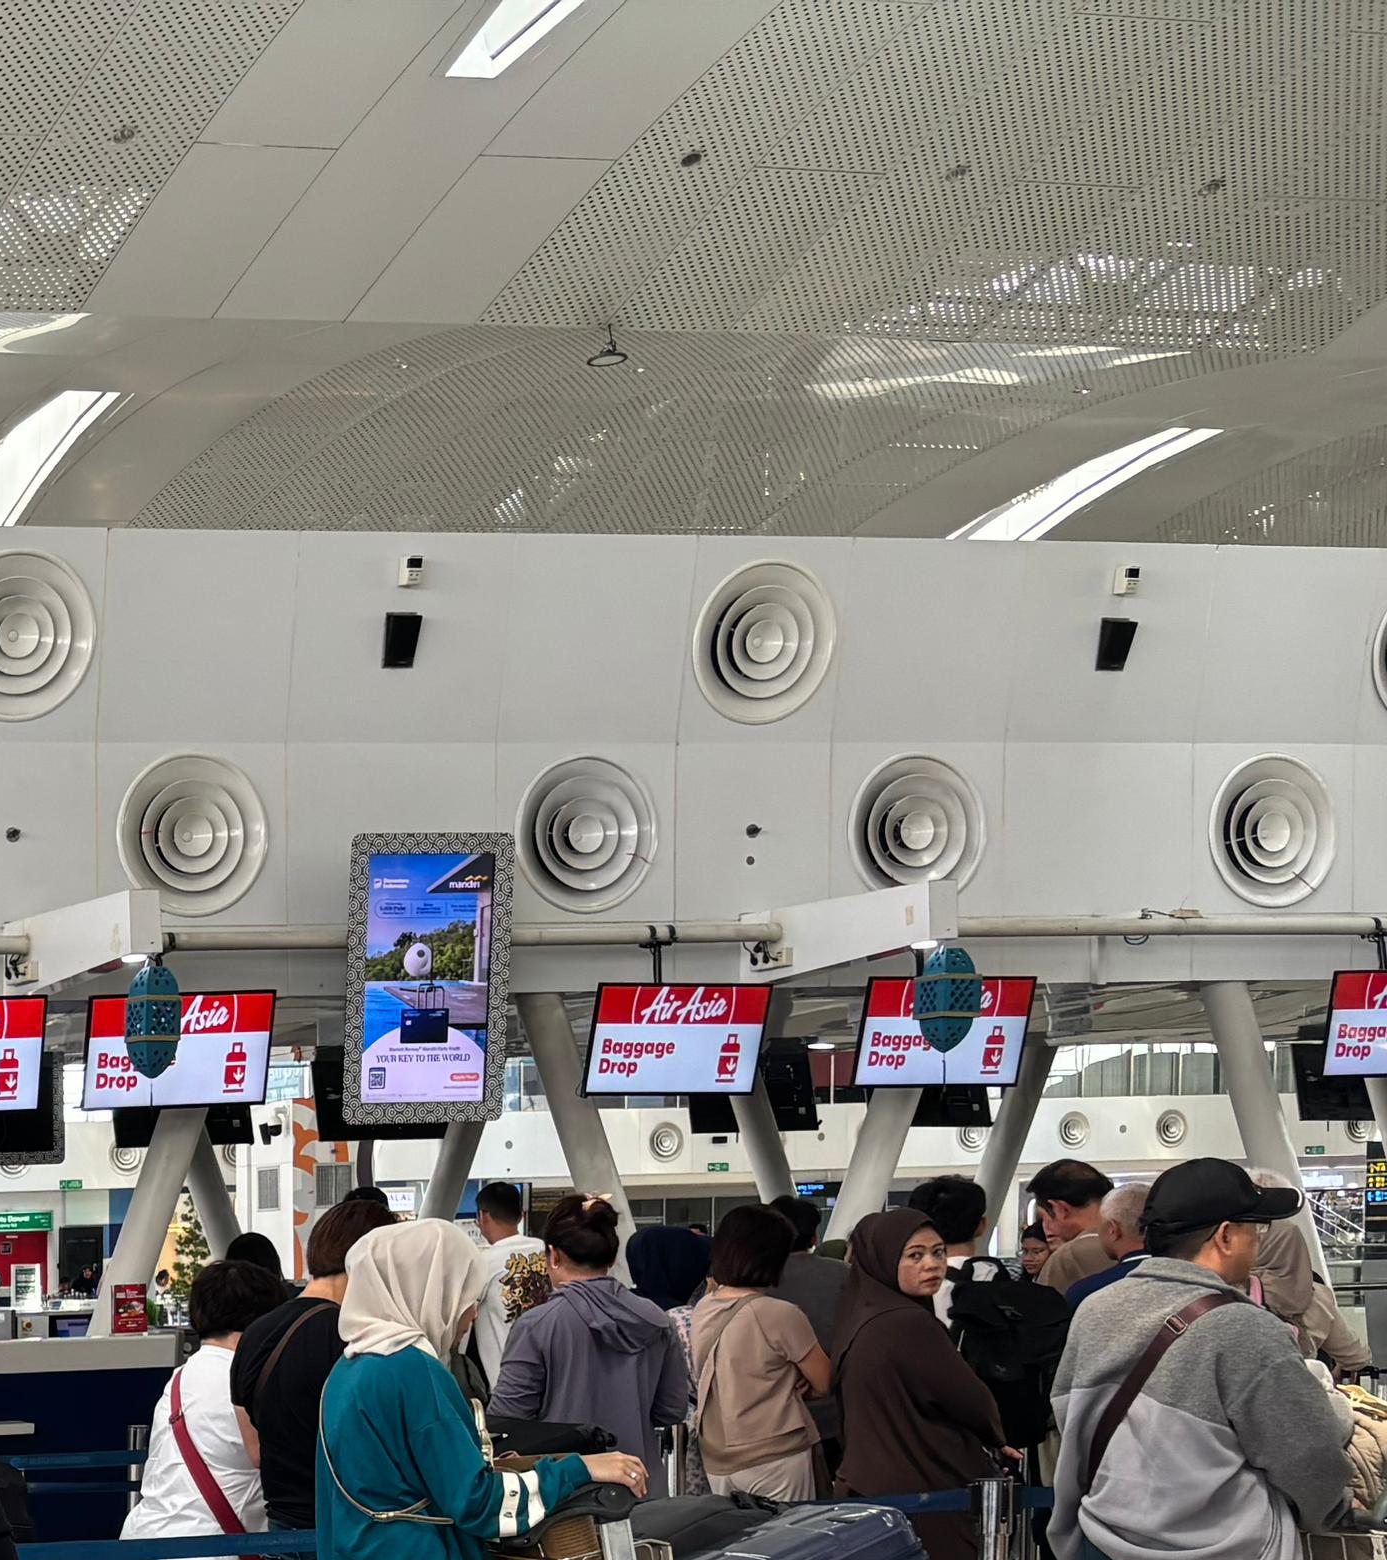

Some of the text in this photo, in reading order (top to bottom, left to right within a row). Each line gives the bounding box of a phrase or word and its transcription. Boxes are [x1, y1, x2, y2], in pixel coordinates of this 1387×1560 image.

[1338, 1024, 1387, 1042] Bagga
[398, 1054, 414, 1063] KEY
[416, 1054, 426, 1062] TO
[442, 1053, 471, 1062] WORLD
[602, 1039, 676, 1059] Baggage
[1335, 1043, 1371, 1060] Drop
[598, 1058, 639, 1077] Drop
[867, 1051, 906, 1069] Drop
[96, 1073, 138, 1091] Drop
